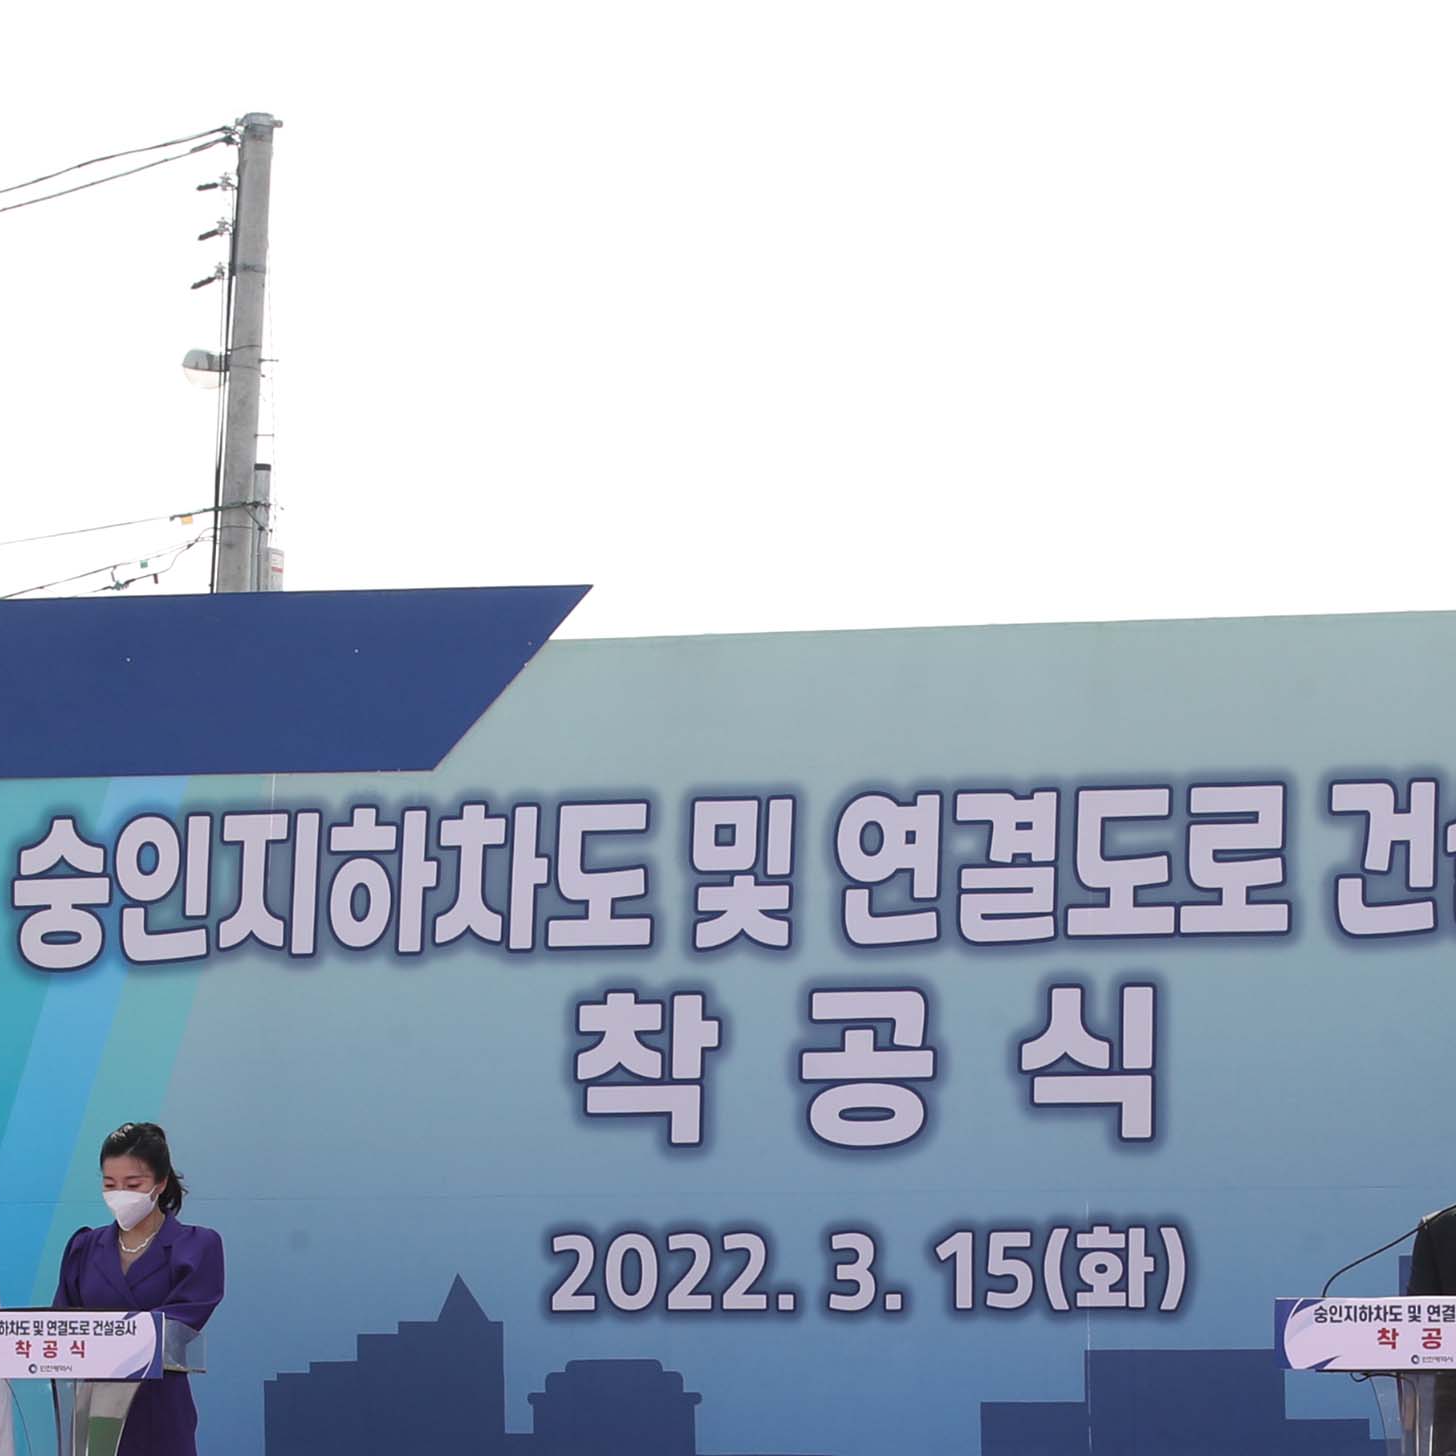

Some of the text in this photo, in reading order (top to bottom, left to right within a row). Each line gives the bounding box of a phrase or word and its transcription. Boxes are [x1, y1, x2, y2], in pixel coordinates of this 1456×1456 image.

[11, 799, 653, 972] 숭인지하차도
[688, 796, 796, 951] 및
[834, 780, 1292, 949] 연결도로
[549, 1221, 1189, 1314] 2022. 3. 15(화)
[33, 1320, 44, 1336] 및
[47, 1320, 90, 1336] 연결도로
[93, 1320, 136, 1336] 건설공사
[1313, 1304, 1403, 1323] 숭인지하차도
[1408, 1304, 1422, 1323] 및
